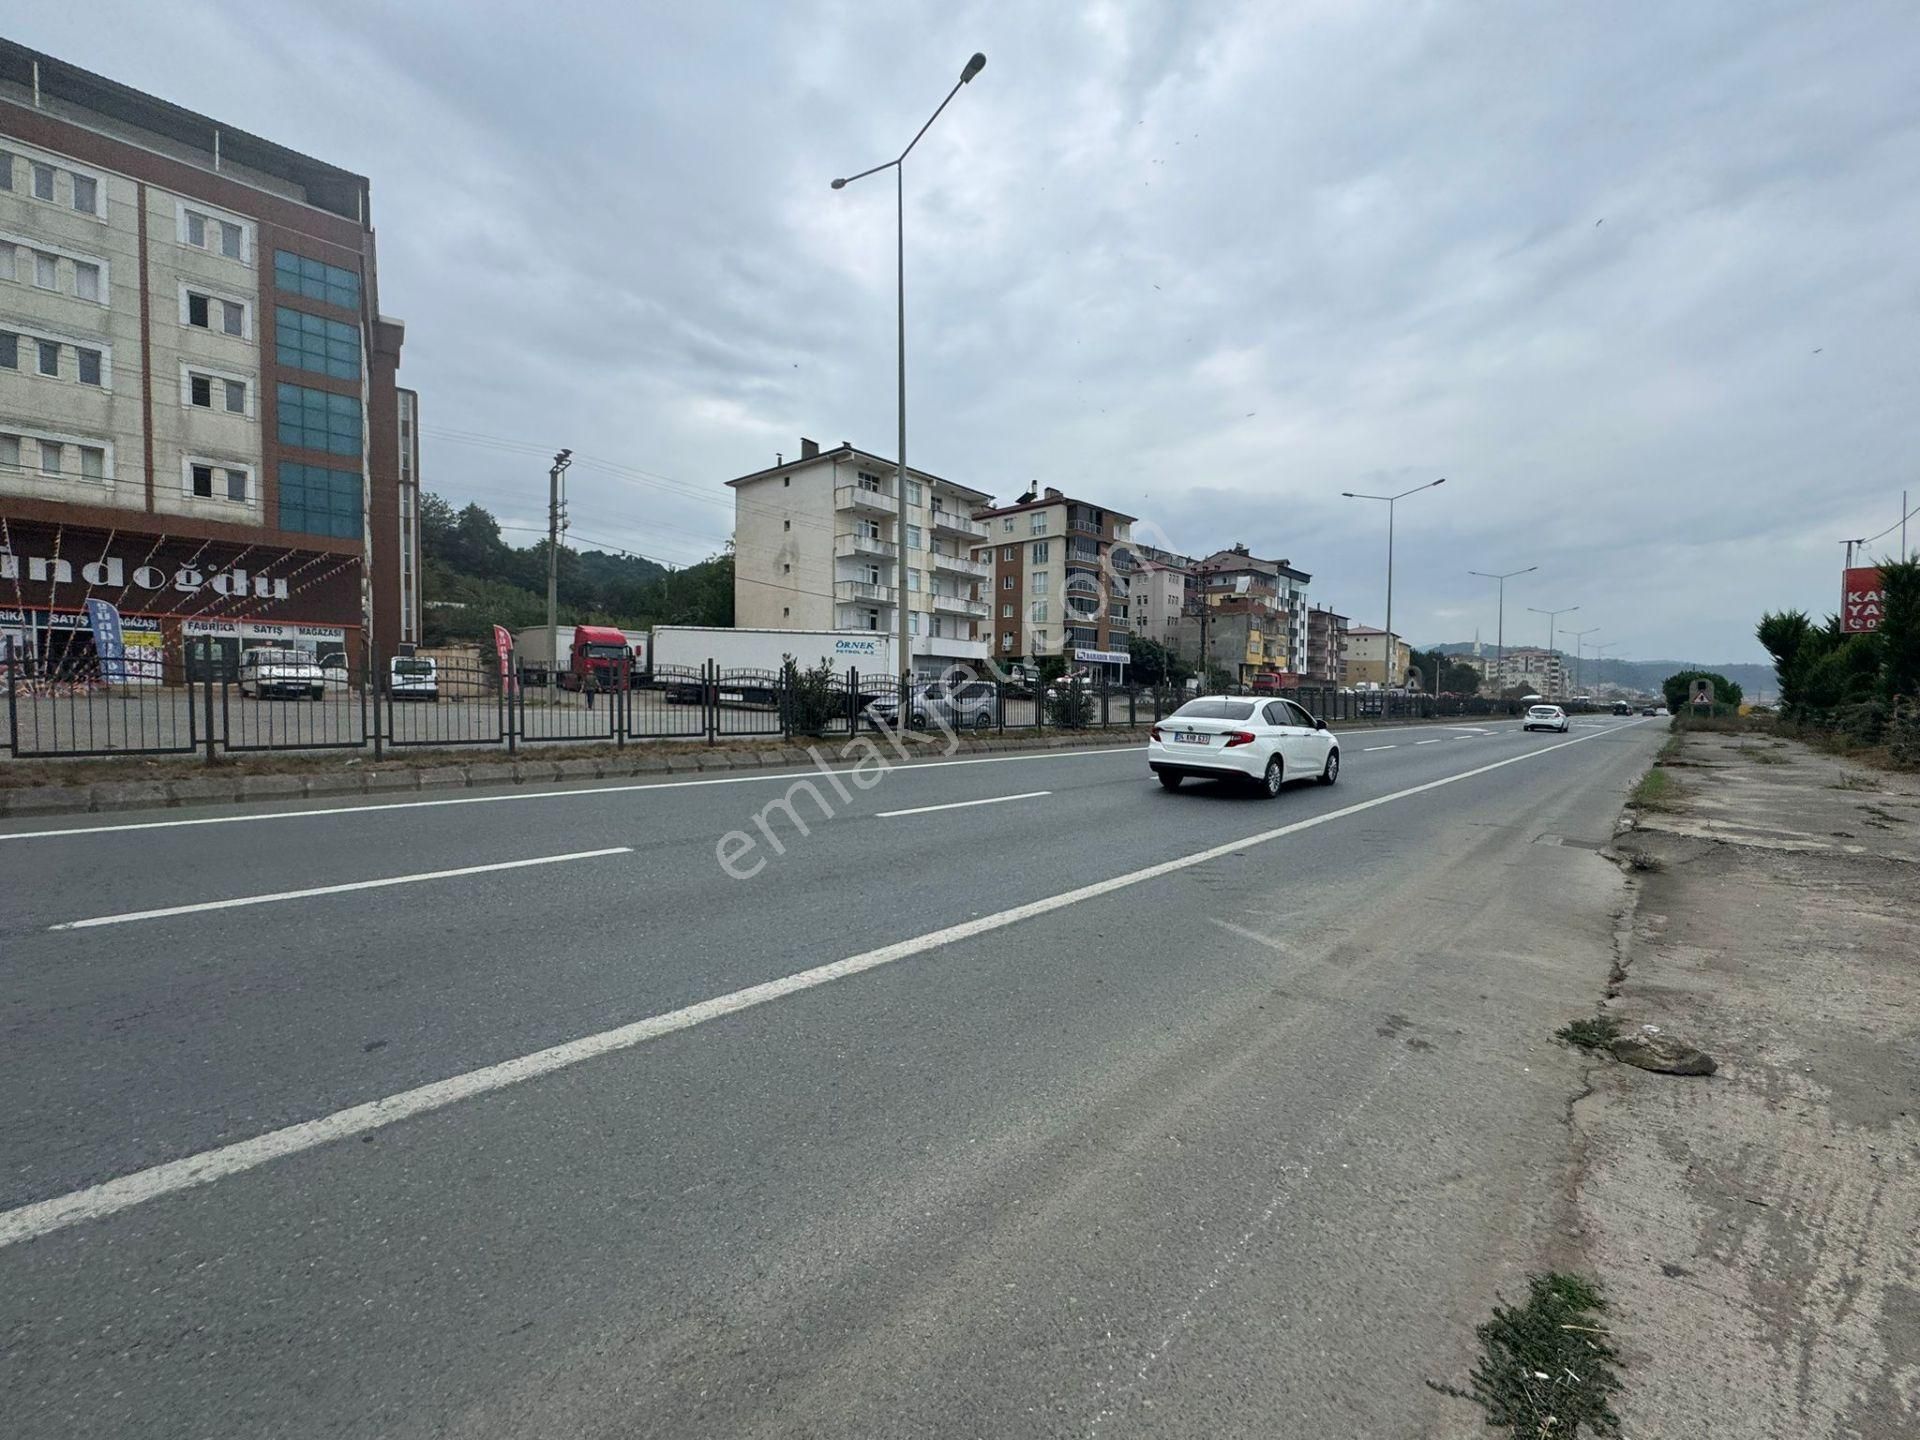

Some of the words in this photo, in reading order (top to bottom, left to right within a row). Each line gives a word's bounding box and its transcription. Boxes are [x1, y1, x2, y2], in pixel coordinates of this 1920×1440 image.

[1848, 604, 1886, 616] YA
[253, 624, 284, 636] SATIŞ
[835, 639, 875, 649] ÖRNEK
